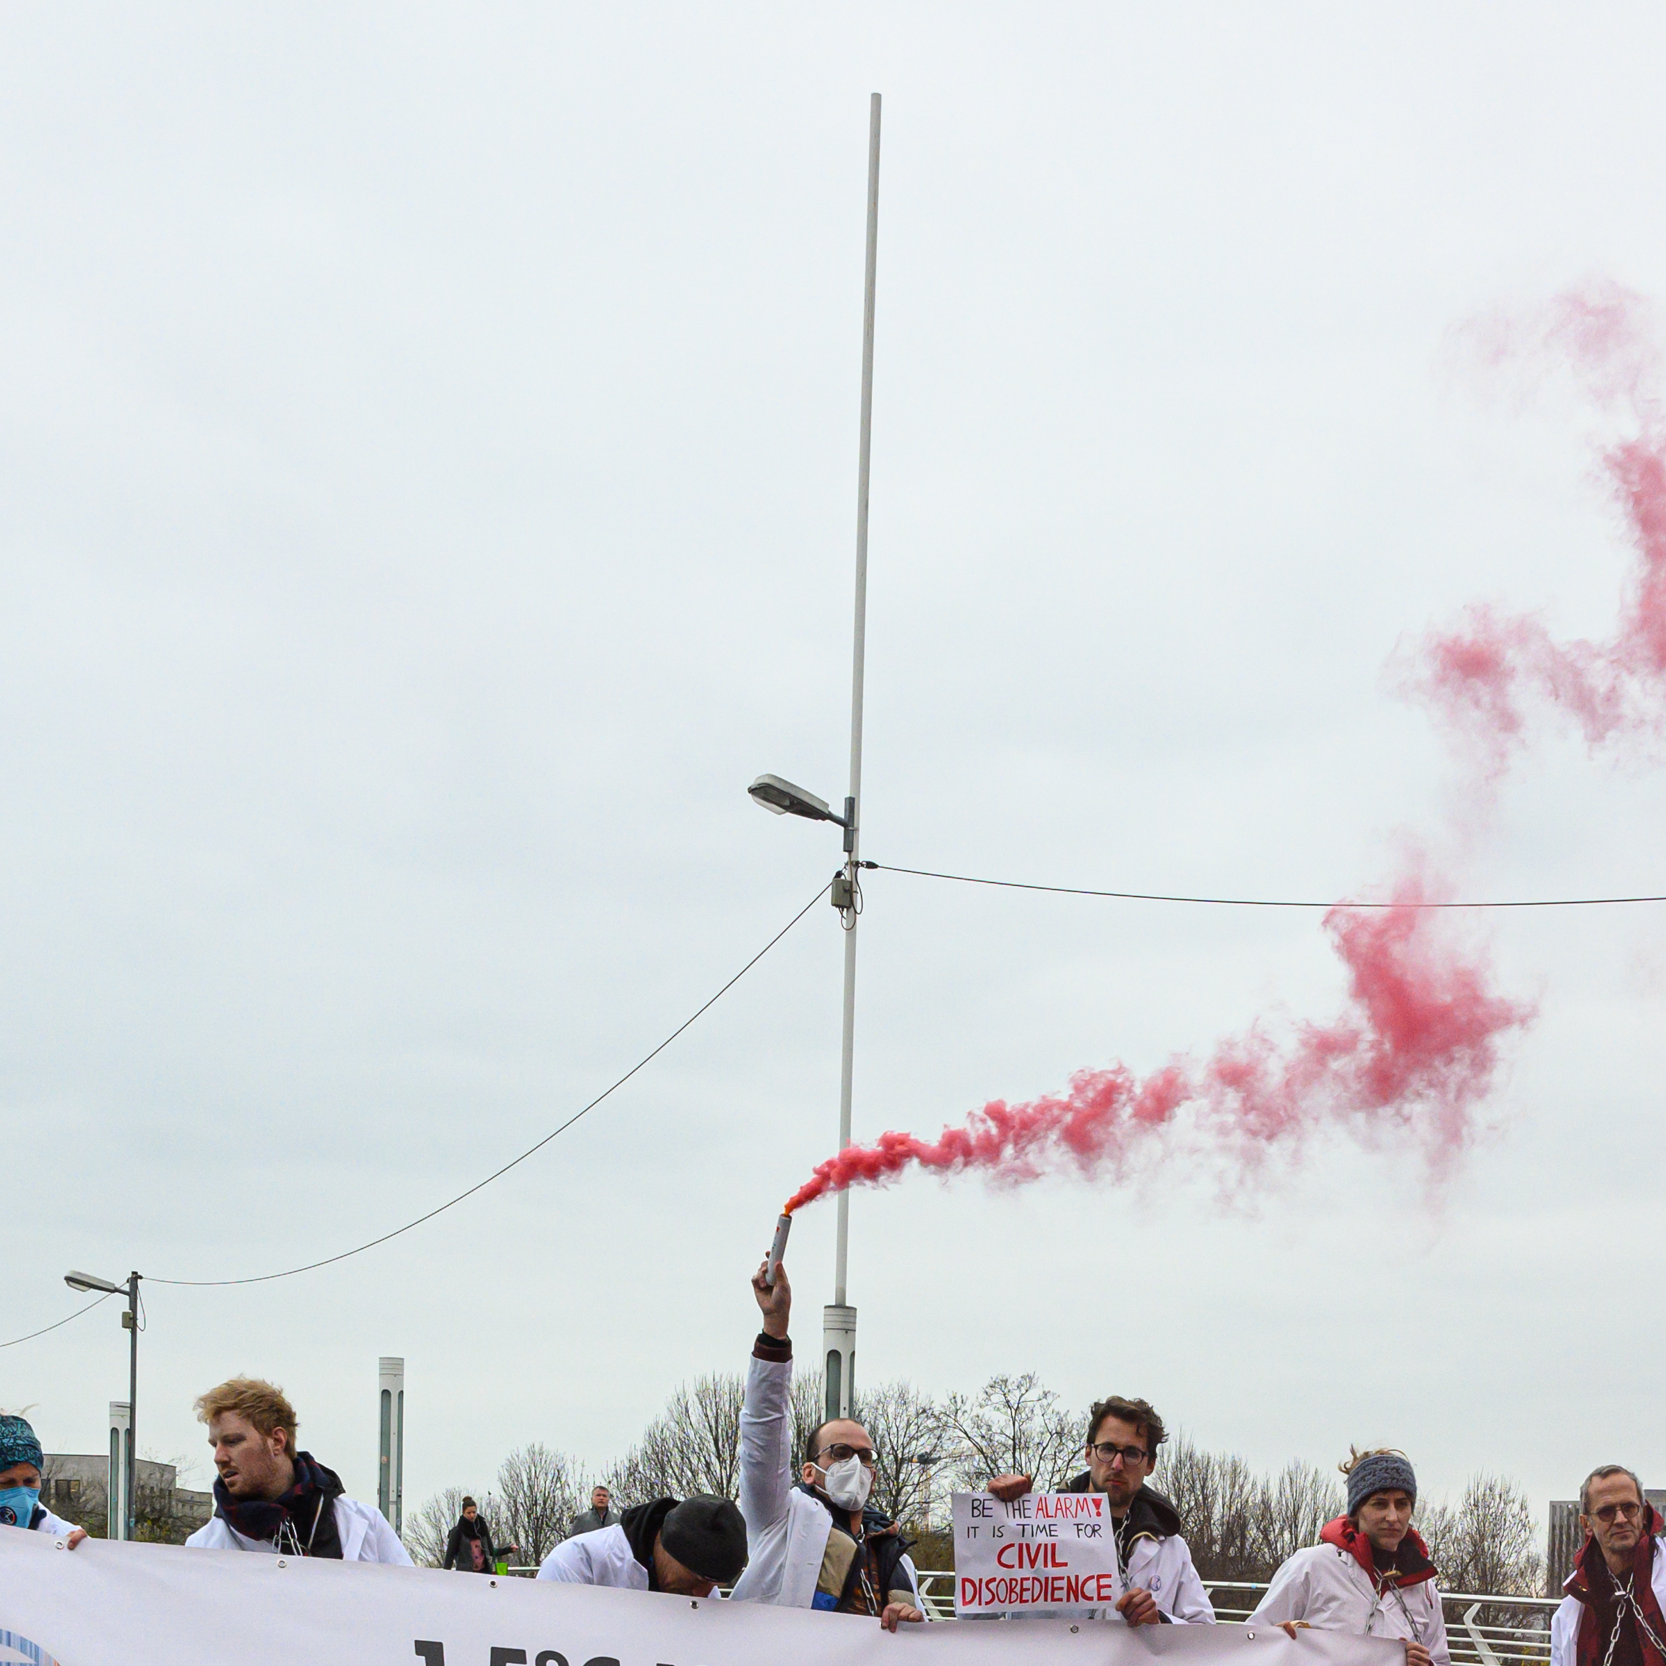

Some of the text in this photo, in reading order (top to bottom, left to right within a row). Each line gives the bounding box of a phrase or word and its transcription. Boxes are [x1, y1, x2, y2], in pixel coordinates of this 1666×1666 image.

[971, 1497, 1103, 1519] BE THE ALARM!
[967, 1524, 1102, 1538] IT IS TIME FOR
[997, 1543, 1068, 1569] CIVIL
[961, 1574, 1112, 1606] DISOBEDIENCE
